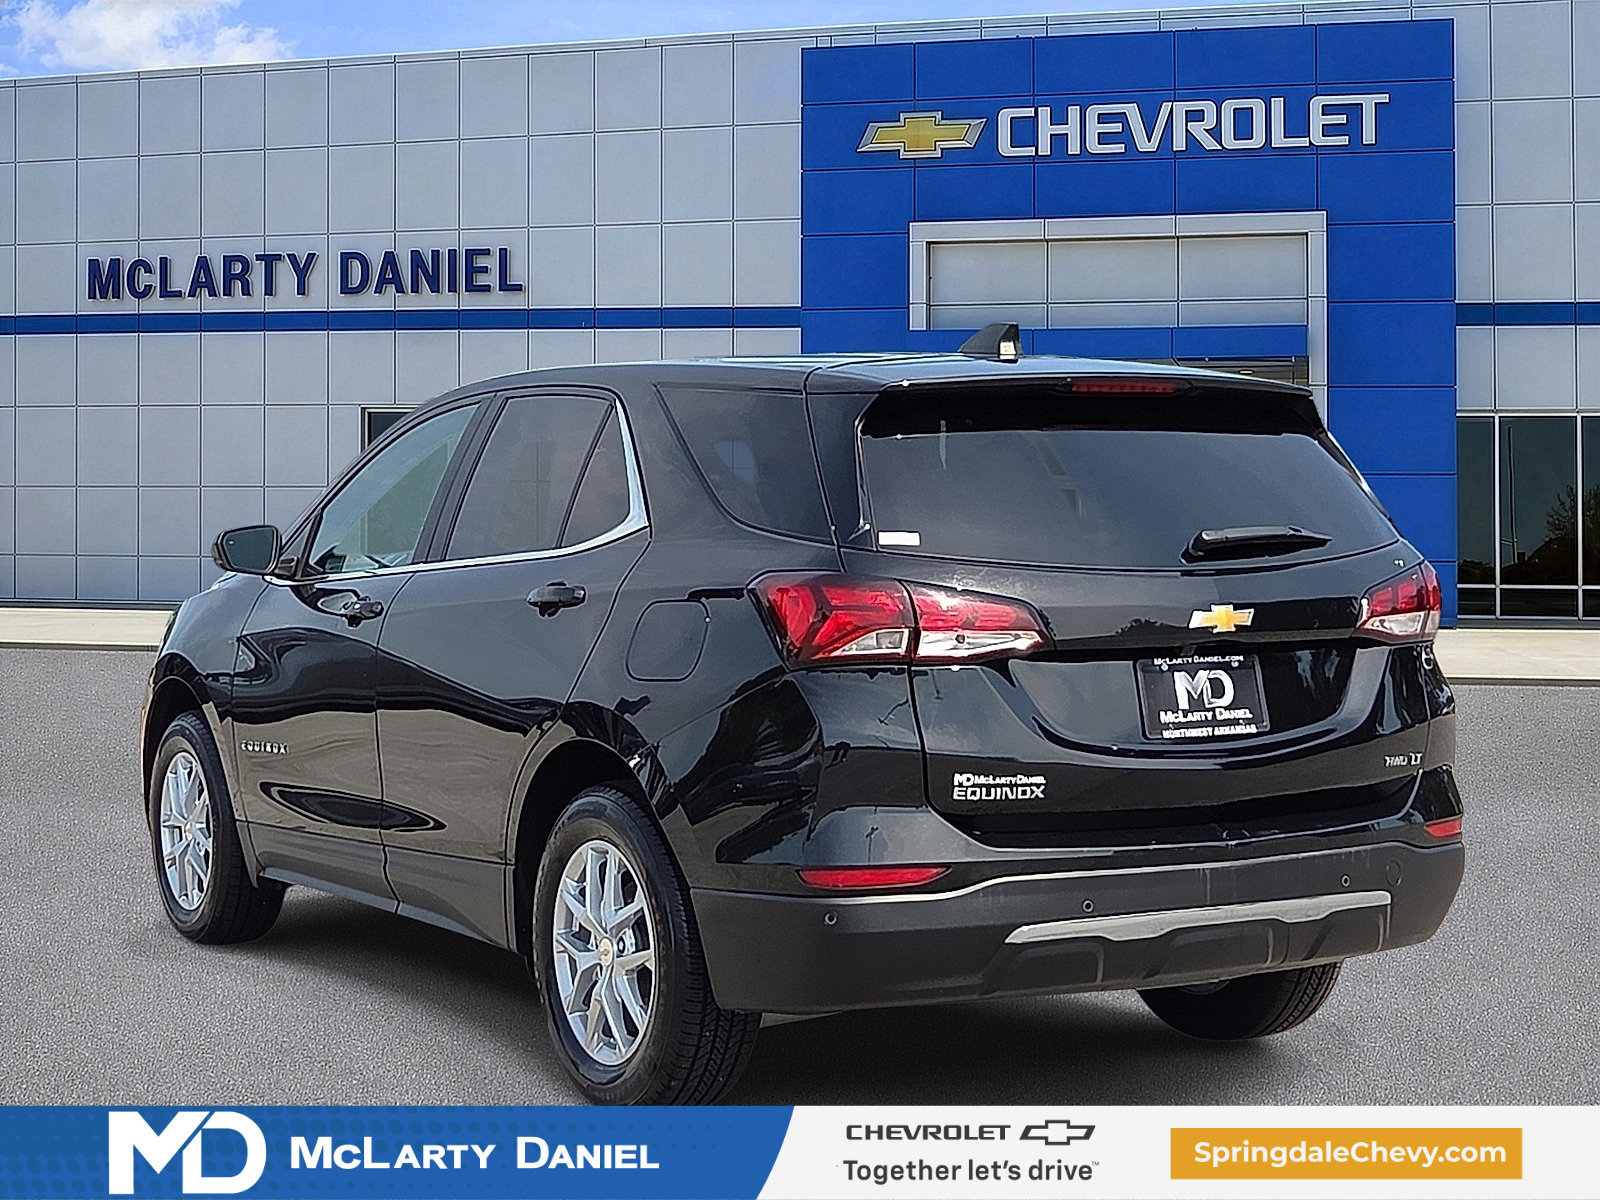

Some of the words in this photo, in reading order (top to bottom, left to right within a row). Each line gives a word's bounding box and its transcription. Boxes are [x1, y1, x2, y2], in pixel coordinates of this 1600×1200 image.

[997, 93, 1390, 157] CHEVROLET
[86, 252, 318, 300] MCLARTY
[339, 246, 525, 297] DANIEL
[1173, 669, 1234, 710] MD
[241, 740, 289, 754] EQUINOX
[953, 785, 1046, 801] EQUINOX
